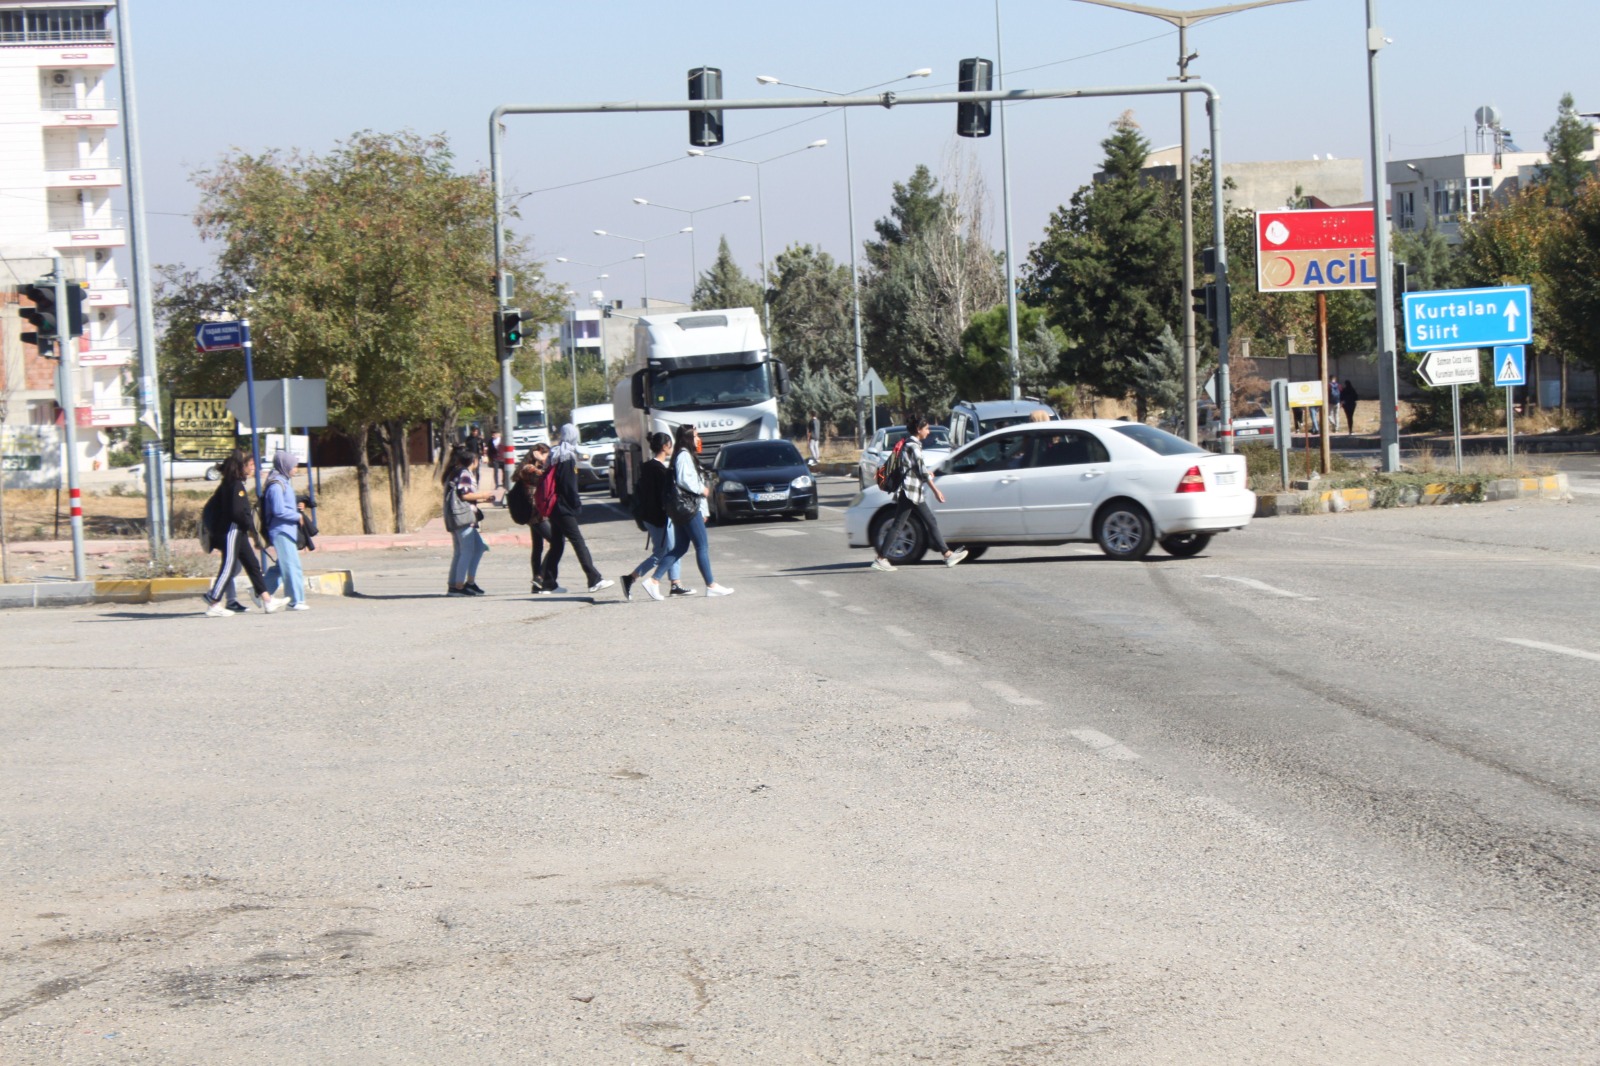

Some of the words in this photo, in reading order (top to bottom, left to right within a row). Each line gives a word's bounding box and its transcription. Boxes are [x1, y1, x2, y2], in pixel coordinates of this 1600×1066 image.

[1303, 253, 1377, 285] ACİL
[1415, 301, 1497, 319] Kurtalan
[1416, 324, 1458, 340] Siirt
[698, 420, 734, 428] IVECO
